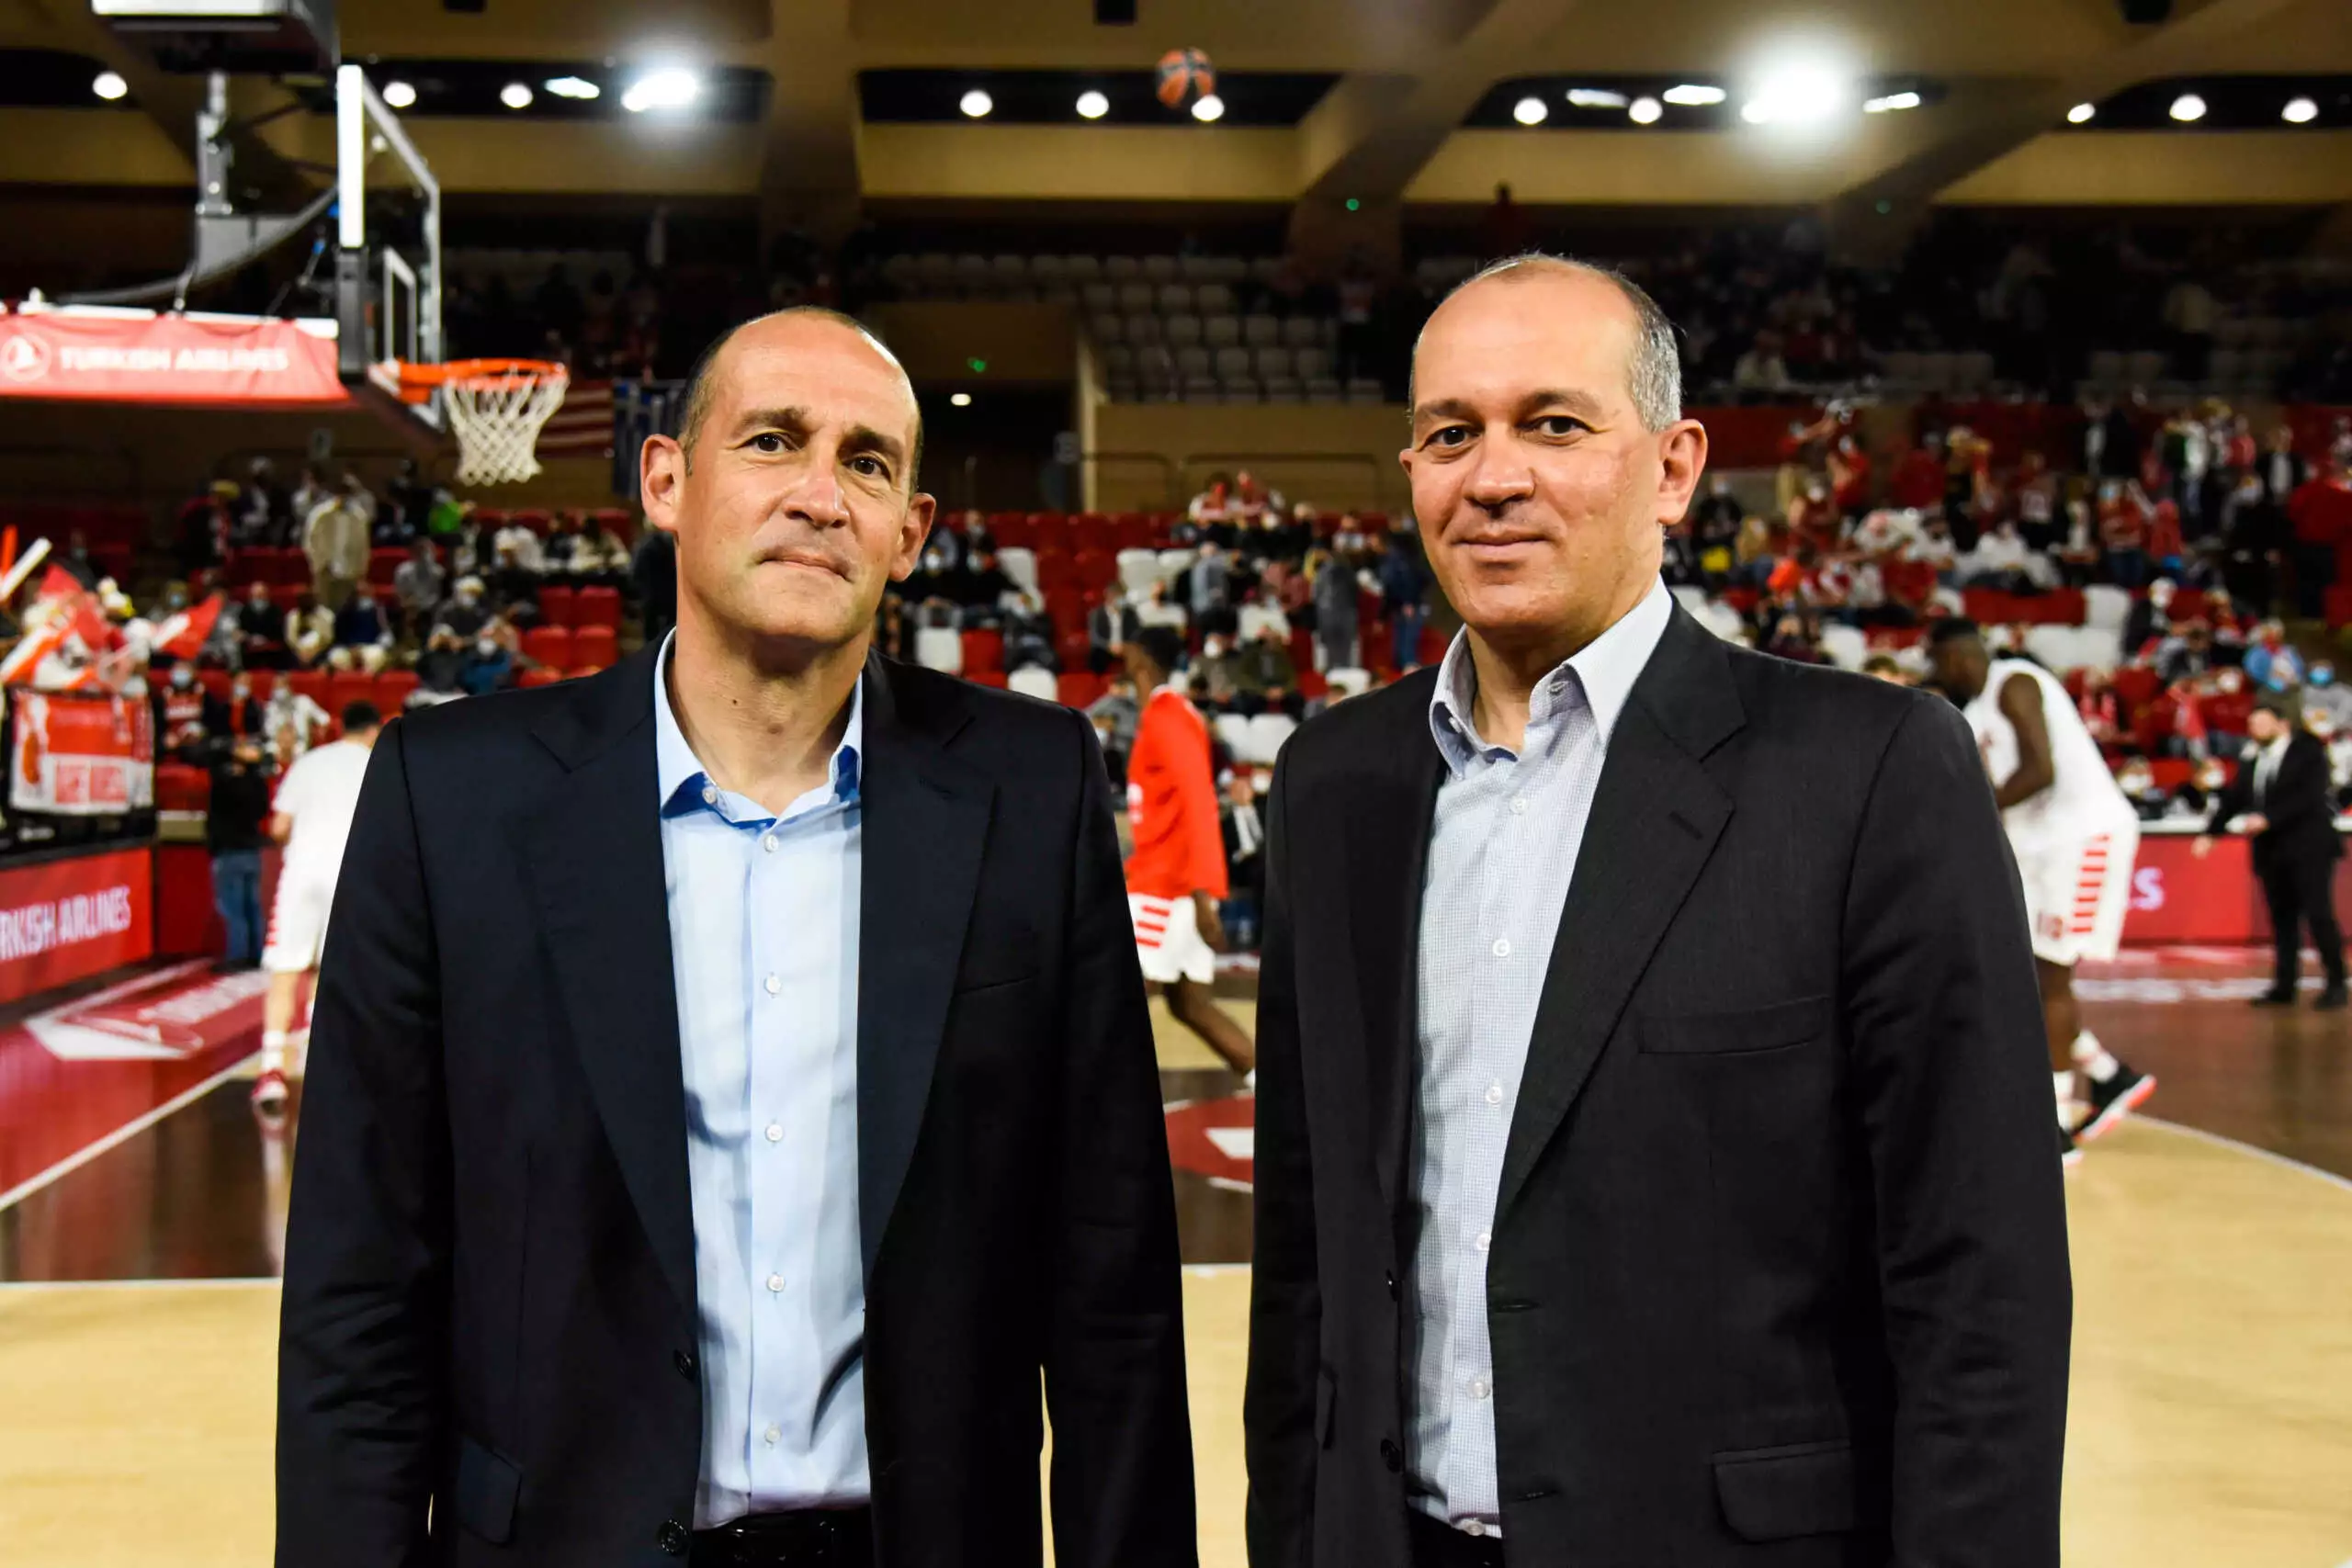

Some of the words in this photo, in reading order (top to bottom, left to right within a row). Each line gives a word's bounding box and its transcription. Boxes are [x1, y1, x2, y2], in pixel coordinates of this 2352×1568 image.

[60, 346, 172, 371] TURKISH
[174, 346, 289, 372] AIRLINES
[0, 902, 57, 960] RKISH
[57, 885, 132, 944] AIRLINES
